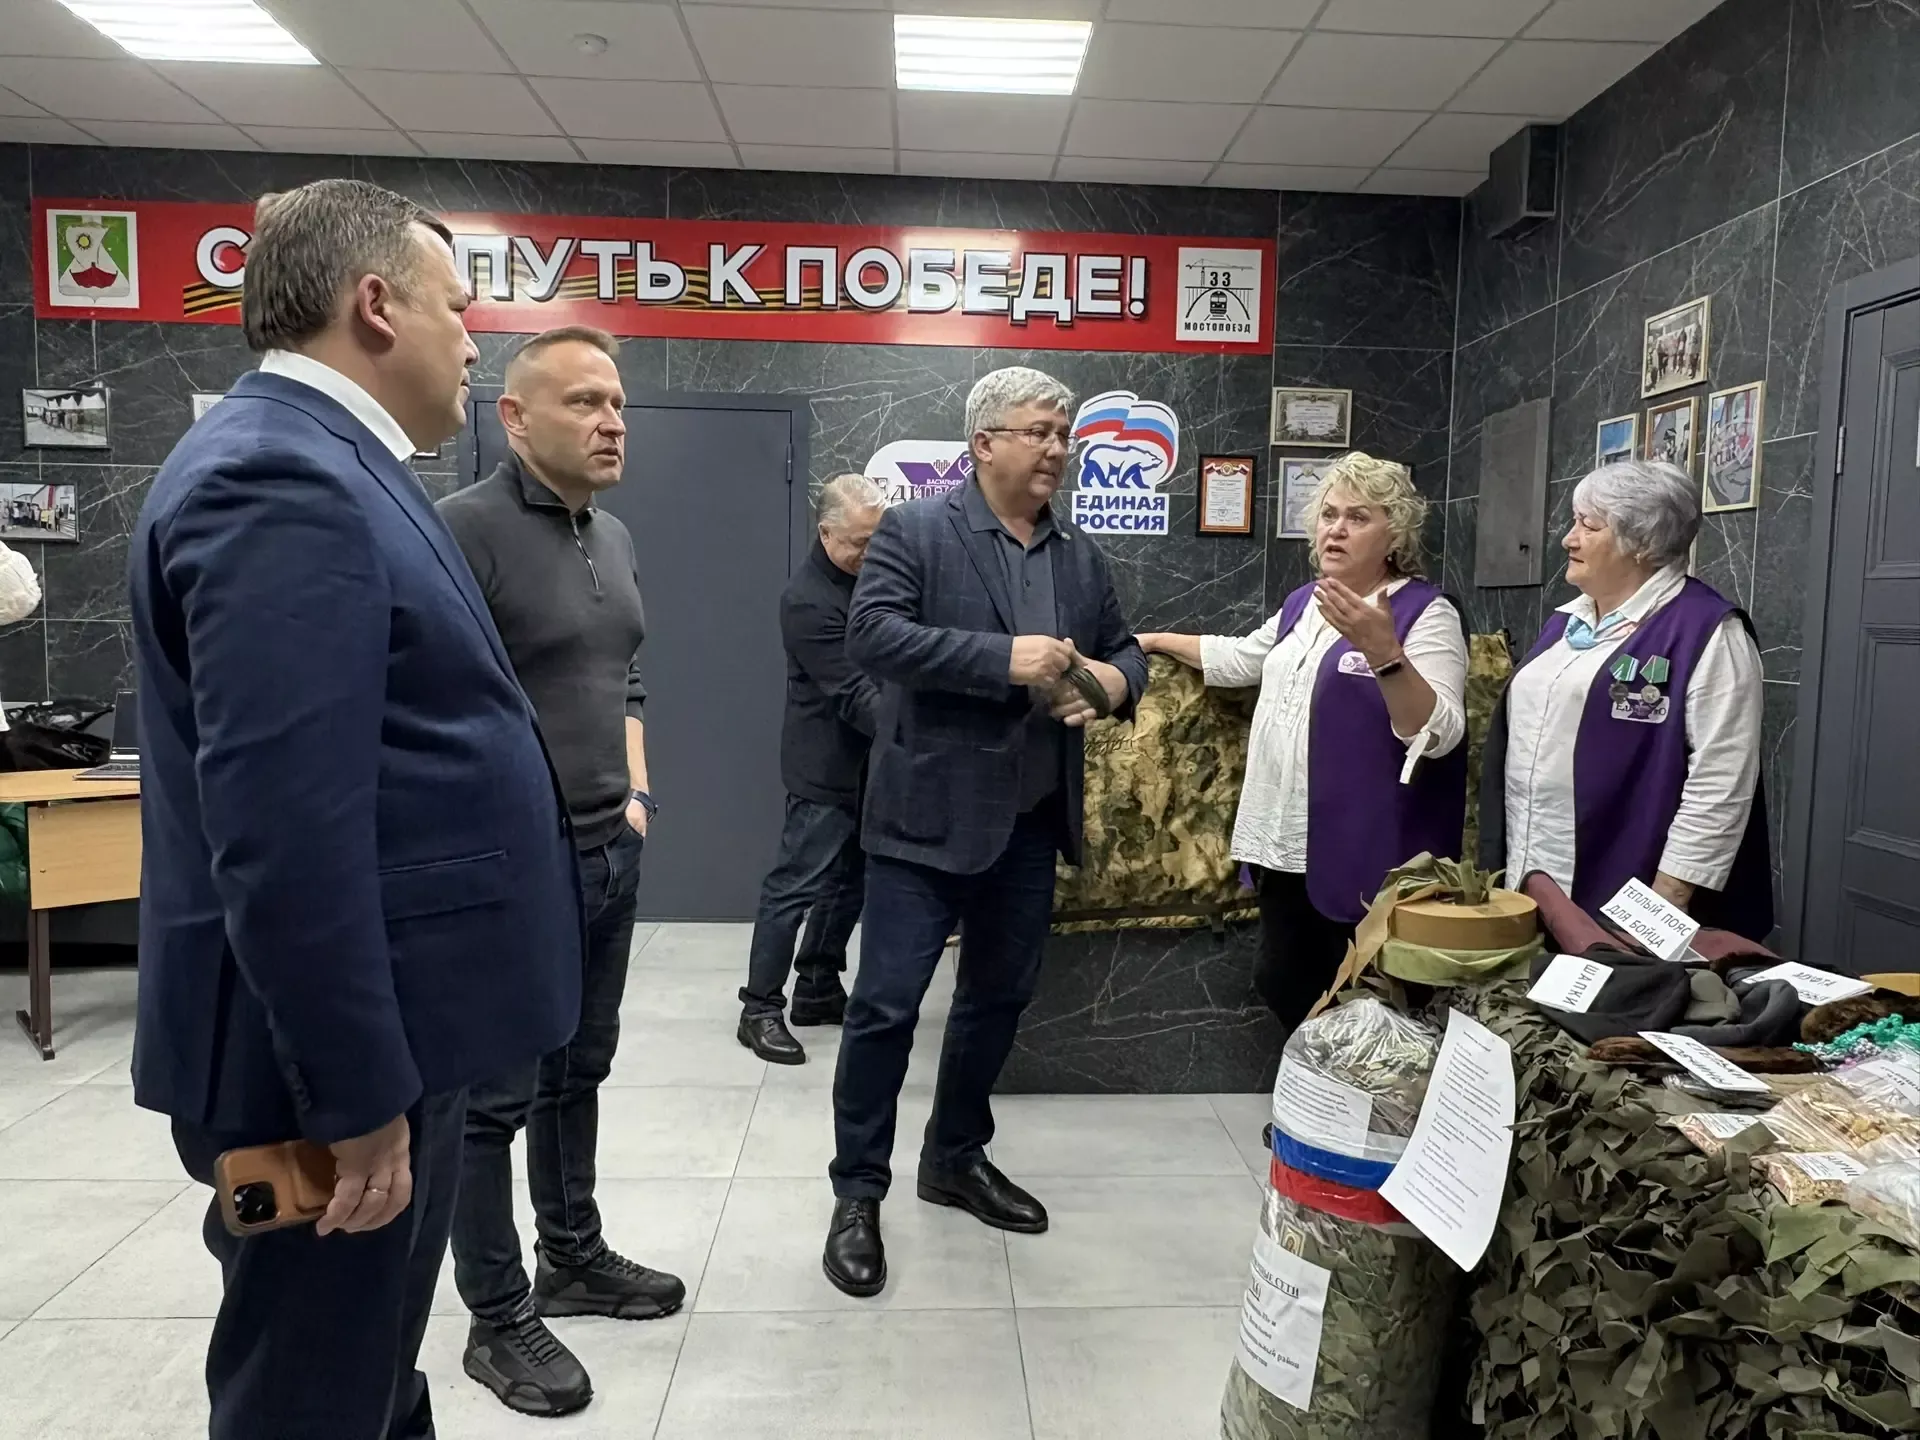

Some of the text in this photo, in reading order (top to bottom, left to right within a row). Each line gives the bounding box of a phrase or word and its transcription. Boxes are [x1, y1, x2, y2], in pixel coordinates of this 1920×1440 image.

[452, 233, 1148, 325] ПУТЬ К ПОБЕДЕ!
[1209, 271, 1231, 287] 33
[1184, 321, 1251, 334] МОСТОПОЕЗД
[1076, 495, 1165, 511] ЕДИНАЯ
[1076, 513, 1165, 531] РОССИЯ
[1623, 885, 1692, 936] ТЕПЛЫЙ ПОЯС
[1605, 904, 1665, 949] ДЛЯ БОЙЦА
[1561, 964, 1600, 1007] ШАПКИ
